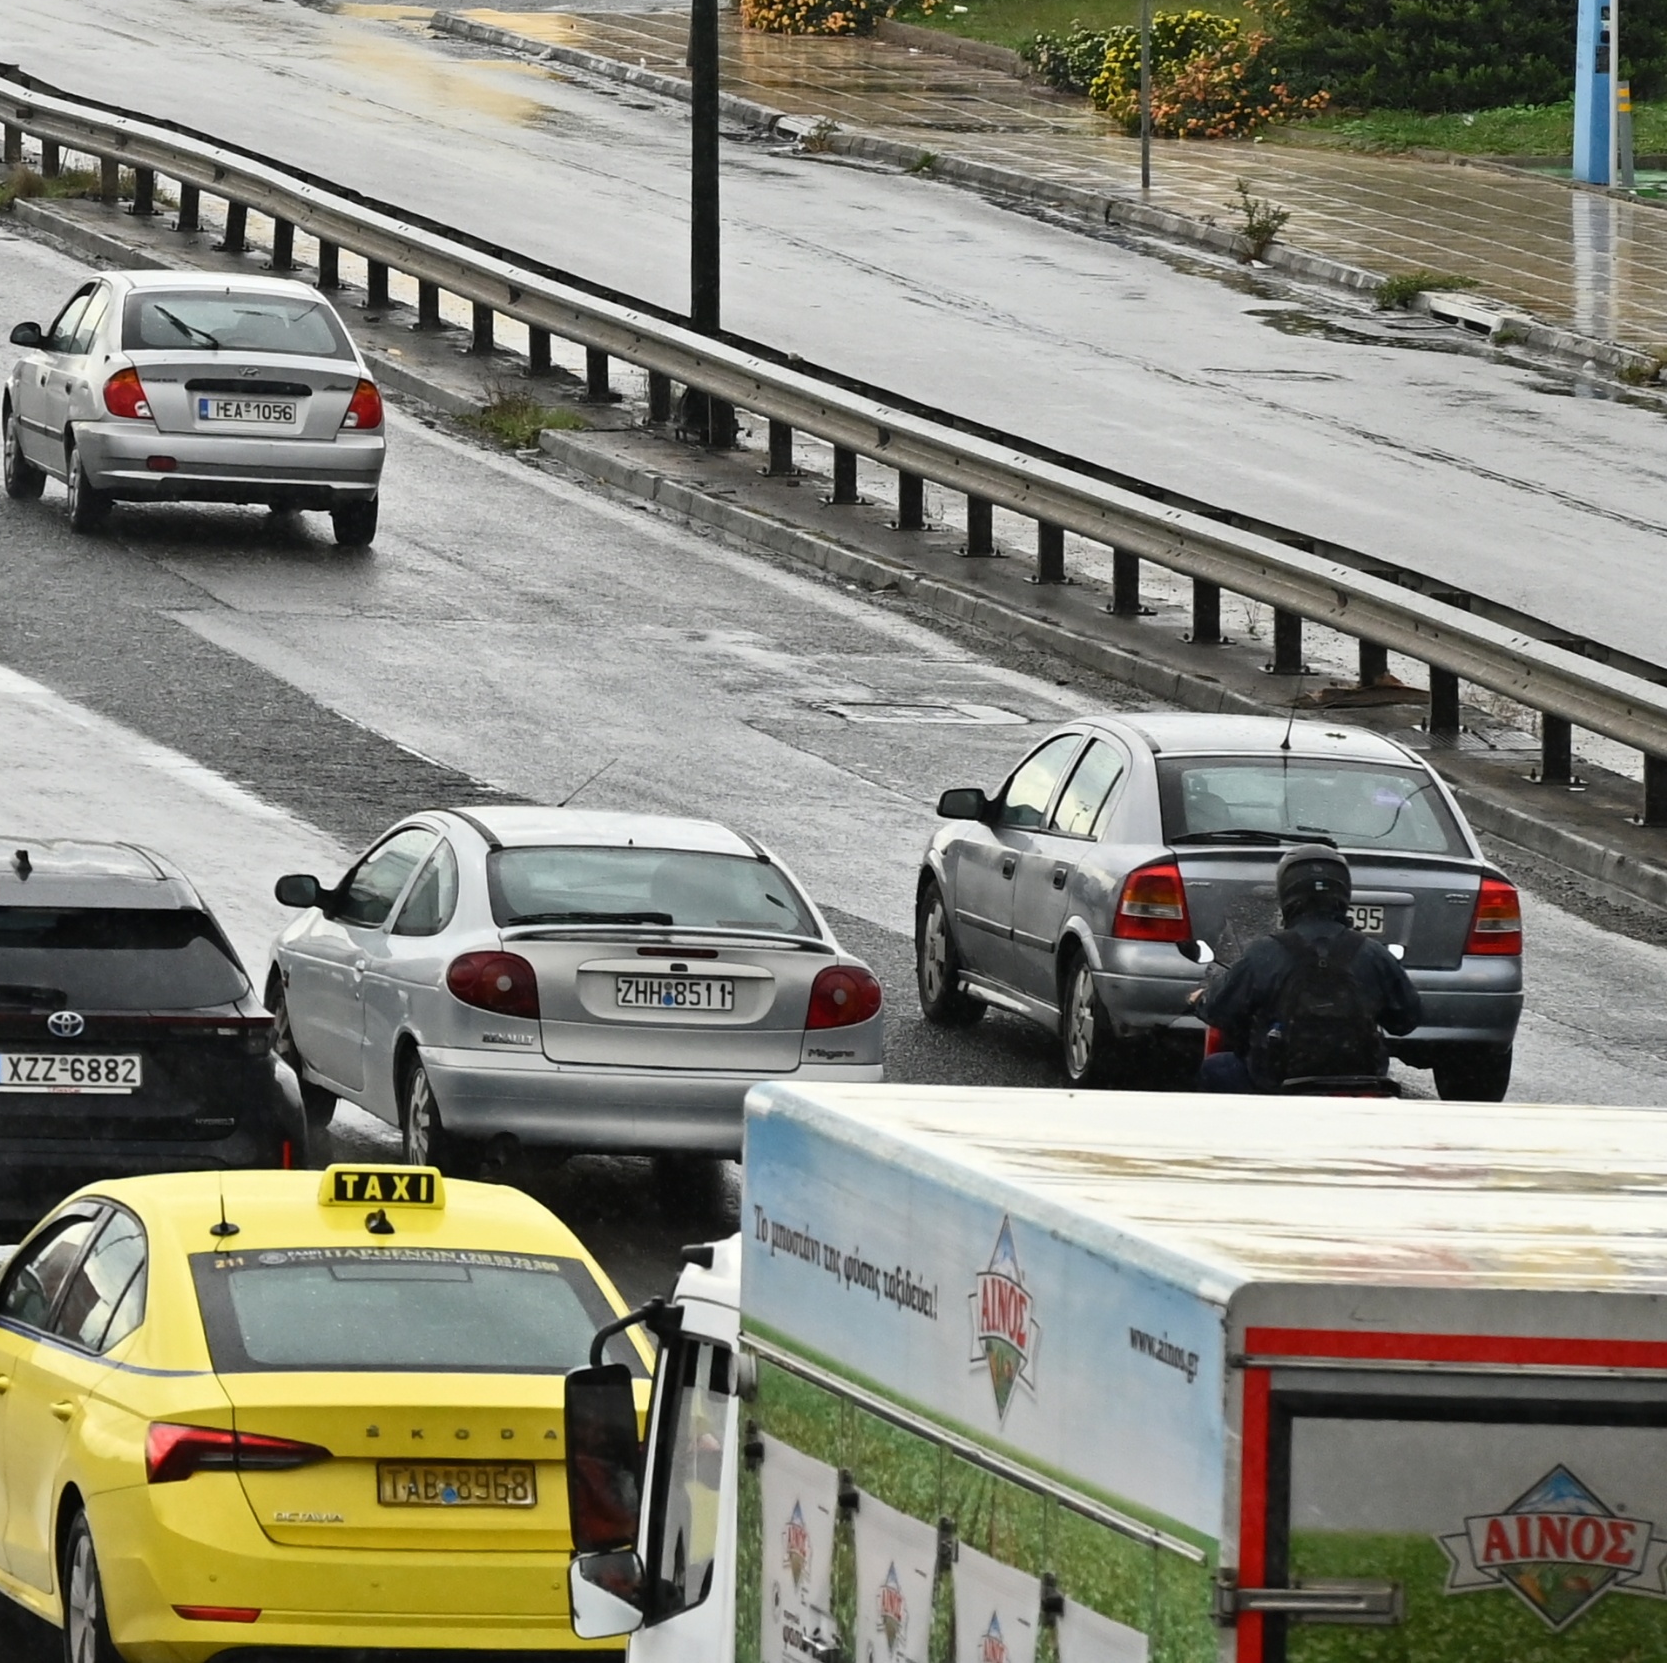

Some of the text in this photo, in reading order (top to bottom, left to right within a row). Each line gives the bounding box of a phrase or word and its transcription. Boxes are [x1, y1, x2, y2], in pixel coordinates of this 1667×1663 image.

[8, 1057, 138, 1084] XZZ-6882
[342, 1174, 428, 1201] TAXI
[214, 1258, 245, 1268] 211
[754, 1204, 938, 1322] Το μποστάνι της φύσης ταξιδεύει!
[981, 1277, 1028, 1347] ΑΙΝΟΣ
[1129, 1327, 1200, 1384] www.ainos.gr
[273, 1511, 344, 1524] OCTAVIA
[1482, 1517, 1637, 1567] ΑΙΝΟΣ
